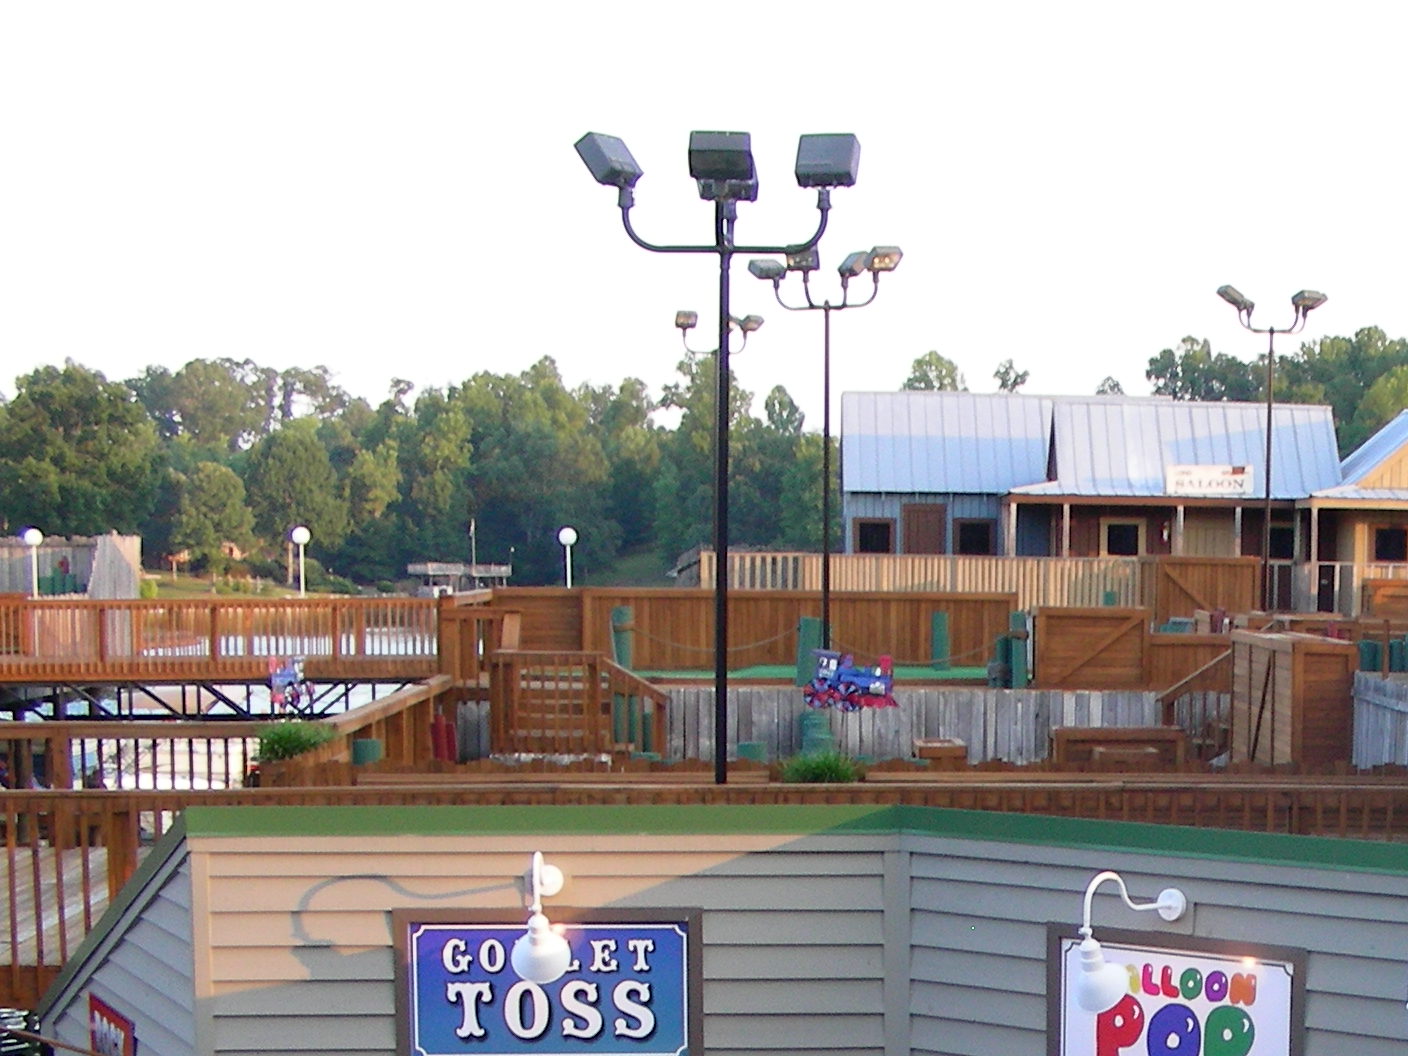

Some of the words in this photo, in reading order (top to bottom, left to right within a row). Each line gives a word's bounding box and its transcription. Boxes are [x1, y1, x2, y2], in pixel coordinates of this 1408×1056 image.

[442, 938, 654, 974] GOET
[1125, 963, 1257, 1006] LLOON
[446, 980, 655, 1039] TOSS
